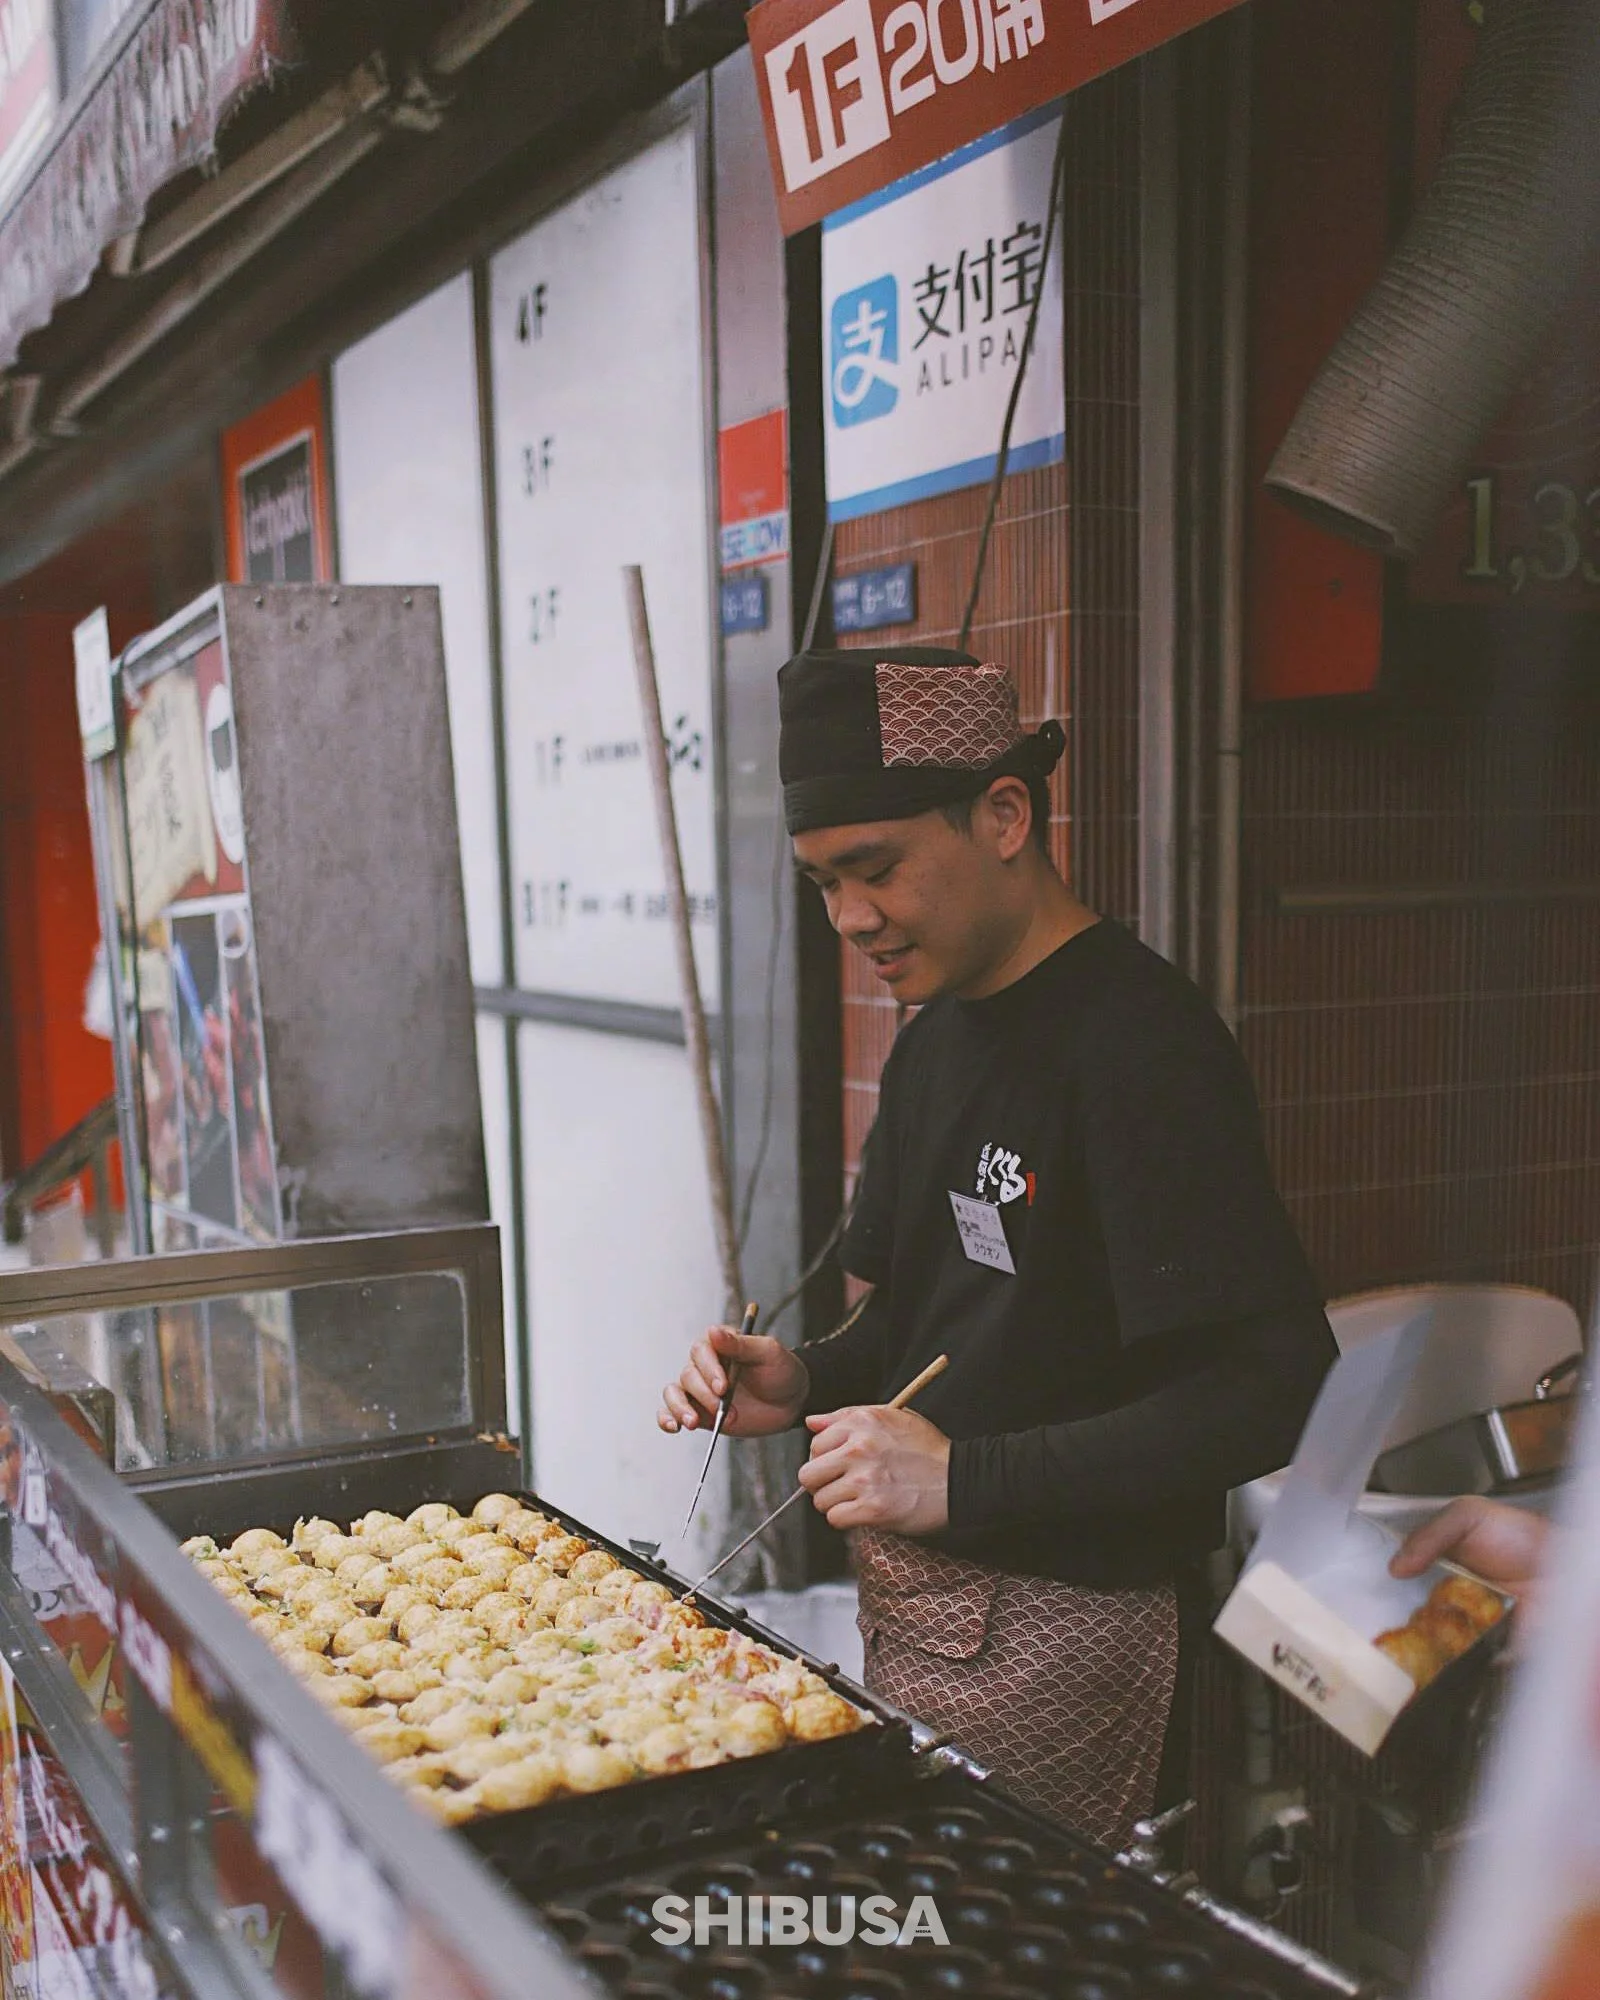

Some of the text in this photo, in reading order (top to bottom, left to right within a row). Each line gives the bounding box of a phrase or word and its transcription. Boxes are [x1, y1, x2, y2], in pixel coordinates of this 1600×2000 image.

[785, 37, 863, 164] 1F
[913, 221, 1042, 350] 支付宝
[916, 327, 1036, 396] ALIPA
